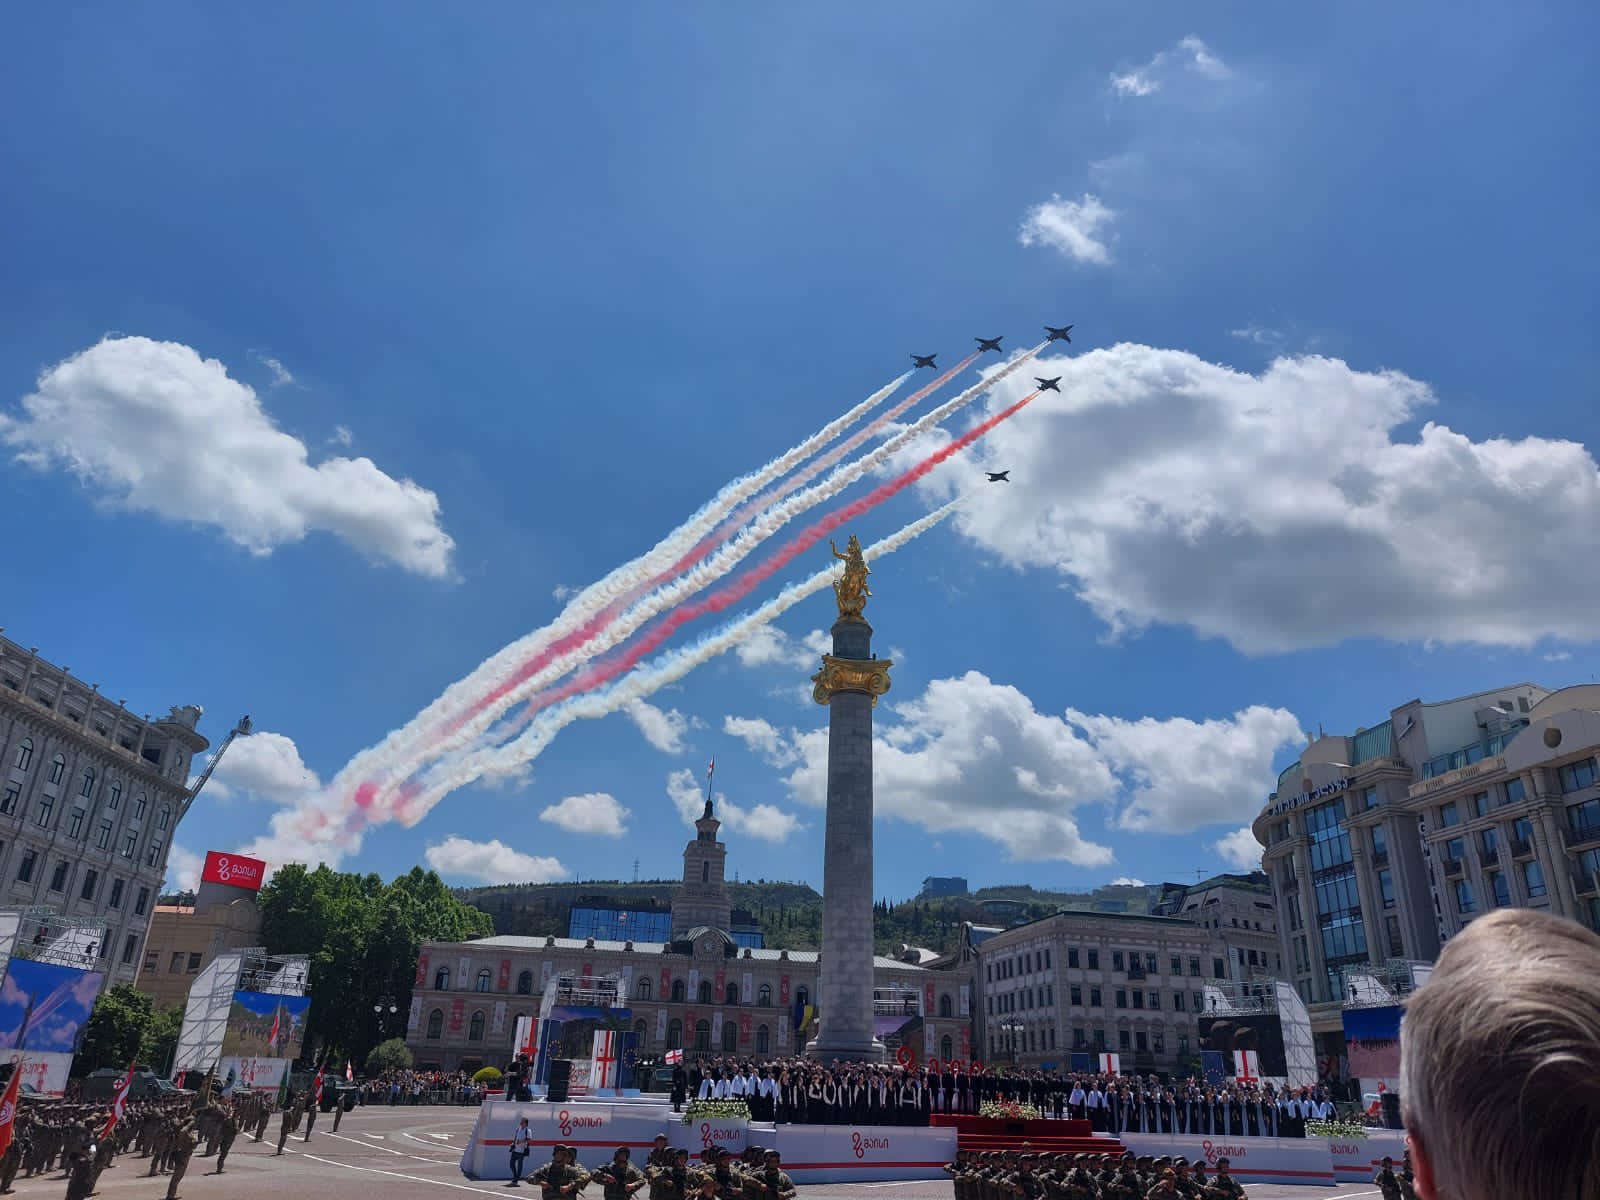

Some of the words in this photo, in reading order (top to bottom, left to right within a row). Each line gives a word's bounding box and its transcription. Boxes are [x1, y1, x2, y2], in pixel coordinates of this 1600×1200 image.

[217, 857, 231, 881] 26
[231, 864, 257, 879] მაისი
[558, 1110, 573, 1137] 26
[573, 1117, 602, 1128] მაისი
[700, 1122, 714, 1149] 26
[713, 1128, 740, 1141] მაისი
[852, 1131, 865, 1159] 26
[863, 1137, 889, 1149] მაისი
[1202, 1139, 1218, 1165] 26
[1216, 1145, 1247, 1158] მაისი
